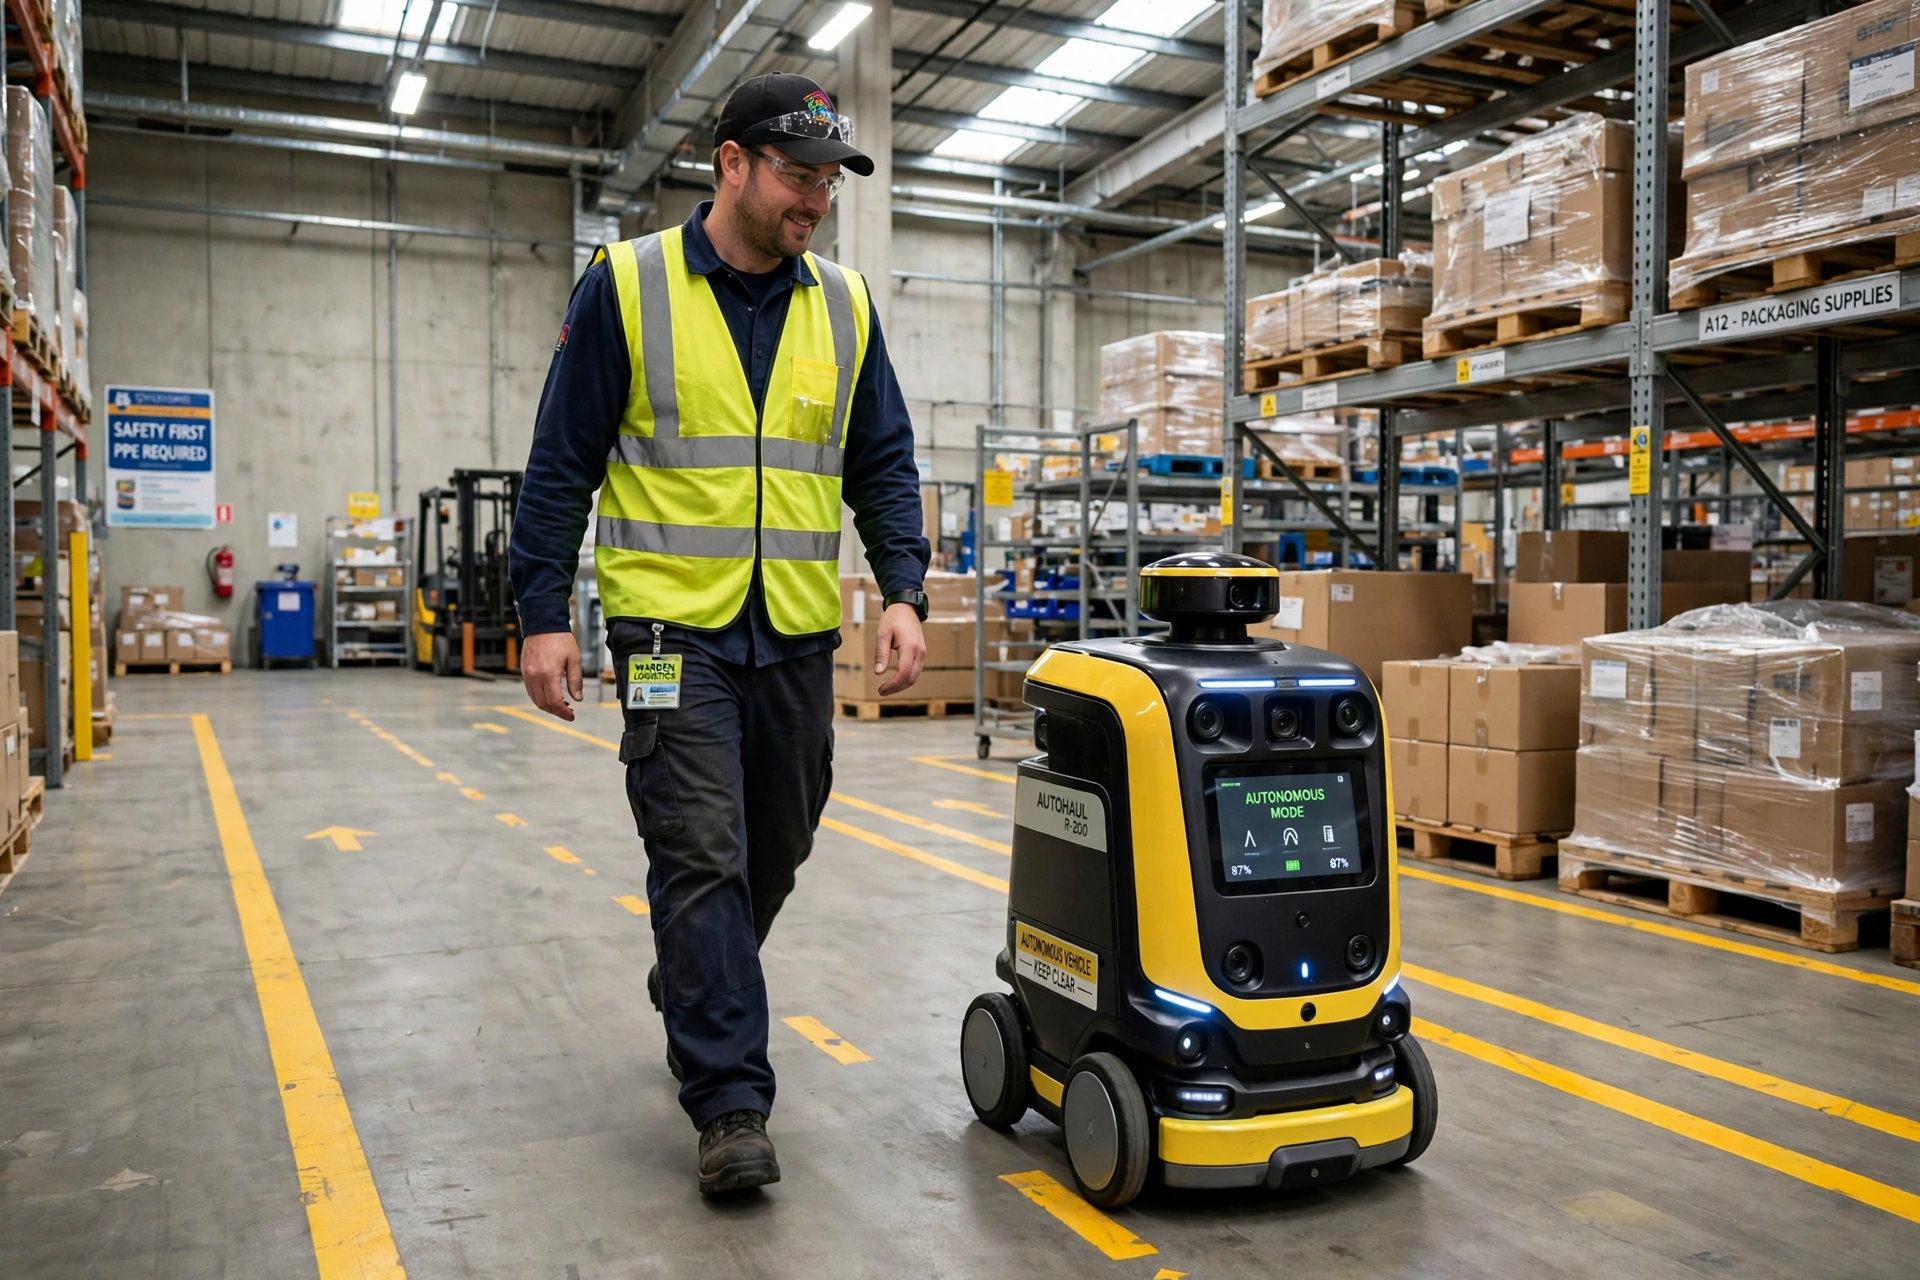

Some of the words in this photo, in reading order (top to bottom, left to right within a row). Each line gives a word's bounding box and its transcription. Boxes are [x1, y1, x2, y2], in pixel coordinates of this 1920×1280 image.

[1705, 315, 1728, 333] A12
[1741, 298, 1820, 327] PACKAGING
[1825, 285, 1893, 312] SUPPLIES
[113, 421, 165, 439] SAFETY
[169, 423, 206, 440] FIRST
[113, 443, 140, 459] PPE
[142, 444, 207, 462] REQUIRED
[635, 663, 675, 673] WARDEN
[1245, 788, 1325, 804] AUTONOMOUS
[1037, 792, 1088, 820] AUTOHAUL
[1270, 806, 1305, 819] MODE
[1064, 818, 1088, 837] R-200
[1231, 865, 1252, 875] 87%
[1330, 857, 1349, 869] 87%
[1021, 931, 1063, 964] AUTONOMOUS
[1064, 950, 1091, 976] VEHICLE
[1033, 959, 1051, 981] KEEP
[1052, 968, 1076, 994] CLEAR
